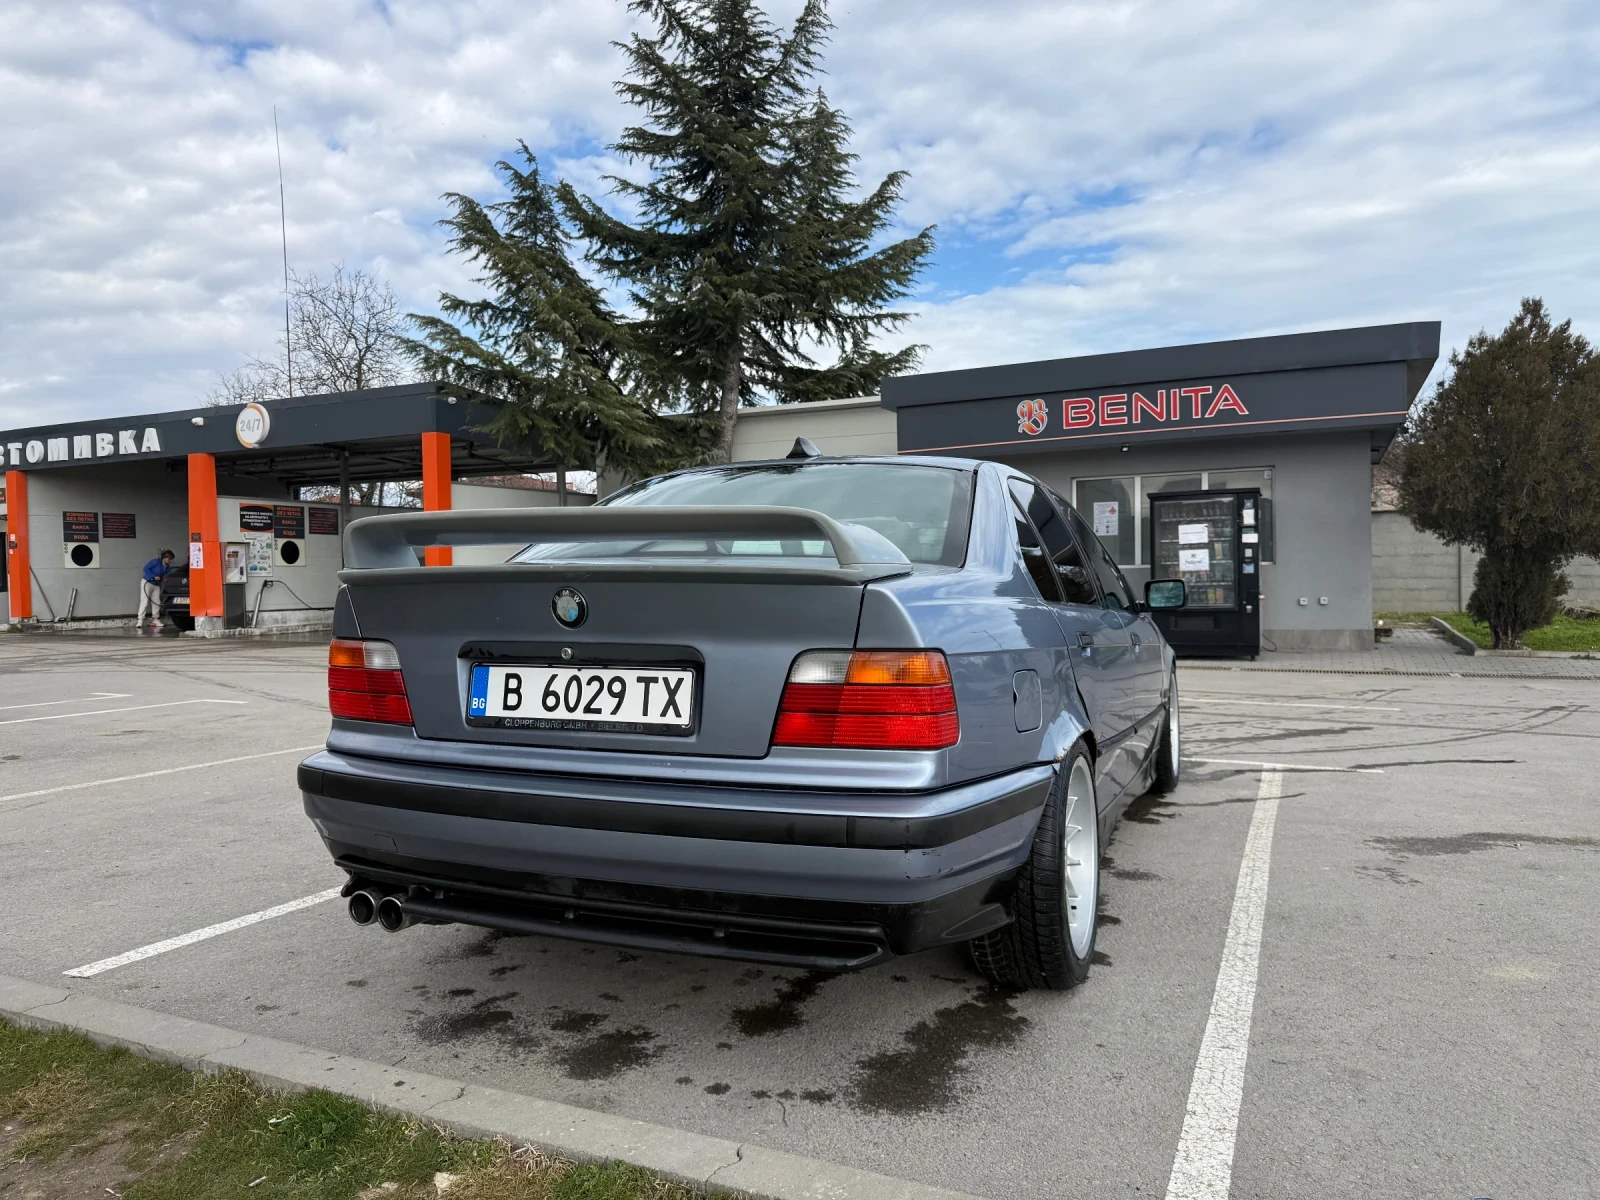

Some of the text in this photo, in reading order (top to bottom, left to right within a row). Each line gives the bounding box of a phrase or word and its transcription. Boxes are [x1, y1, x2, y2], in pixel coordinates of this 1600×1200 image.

[1062, 383, 1249, 430] BENITA
[240, 418, 261, 432] 24/7
[0, 427, 161, 467] ТОМИВКА
[553, 589, 582, 603] BMW
[502, 673, 685, 718] B 6029 TX
[472, 697, 486, 709] BG
[504, 718, 562, 729] CLOPPENBURG
